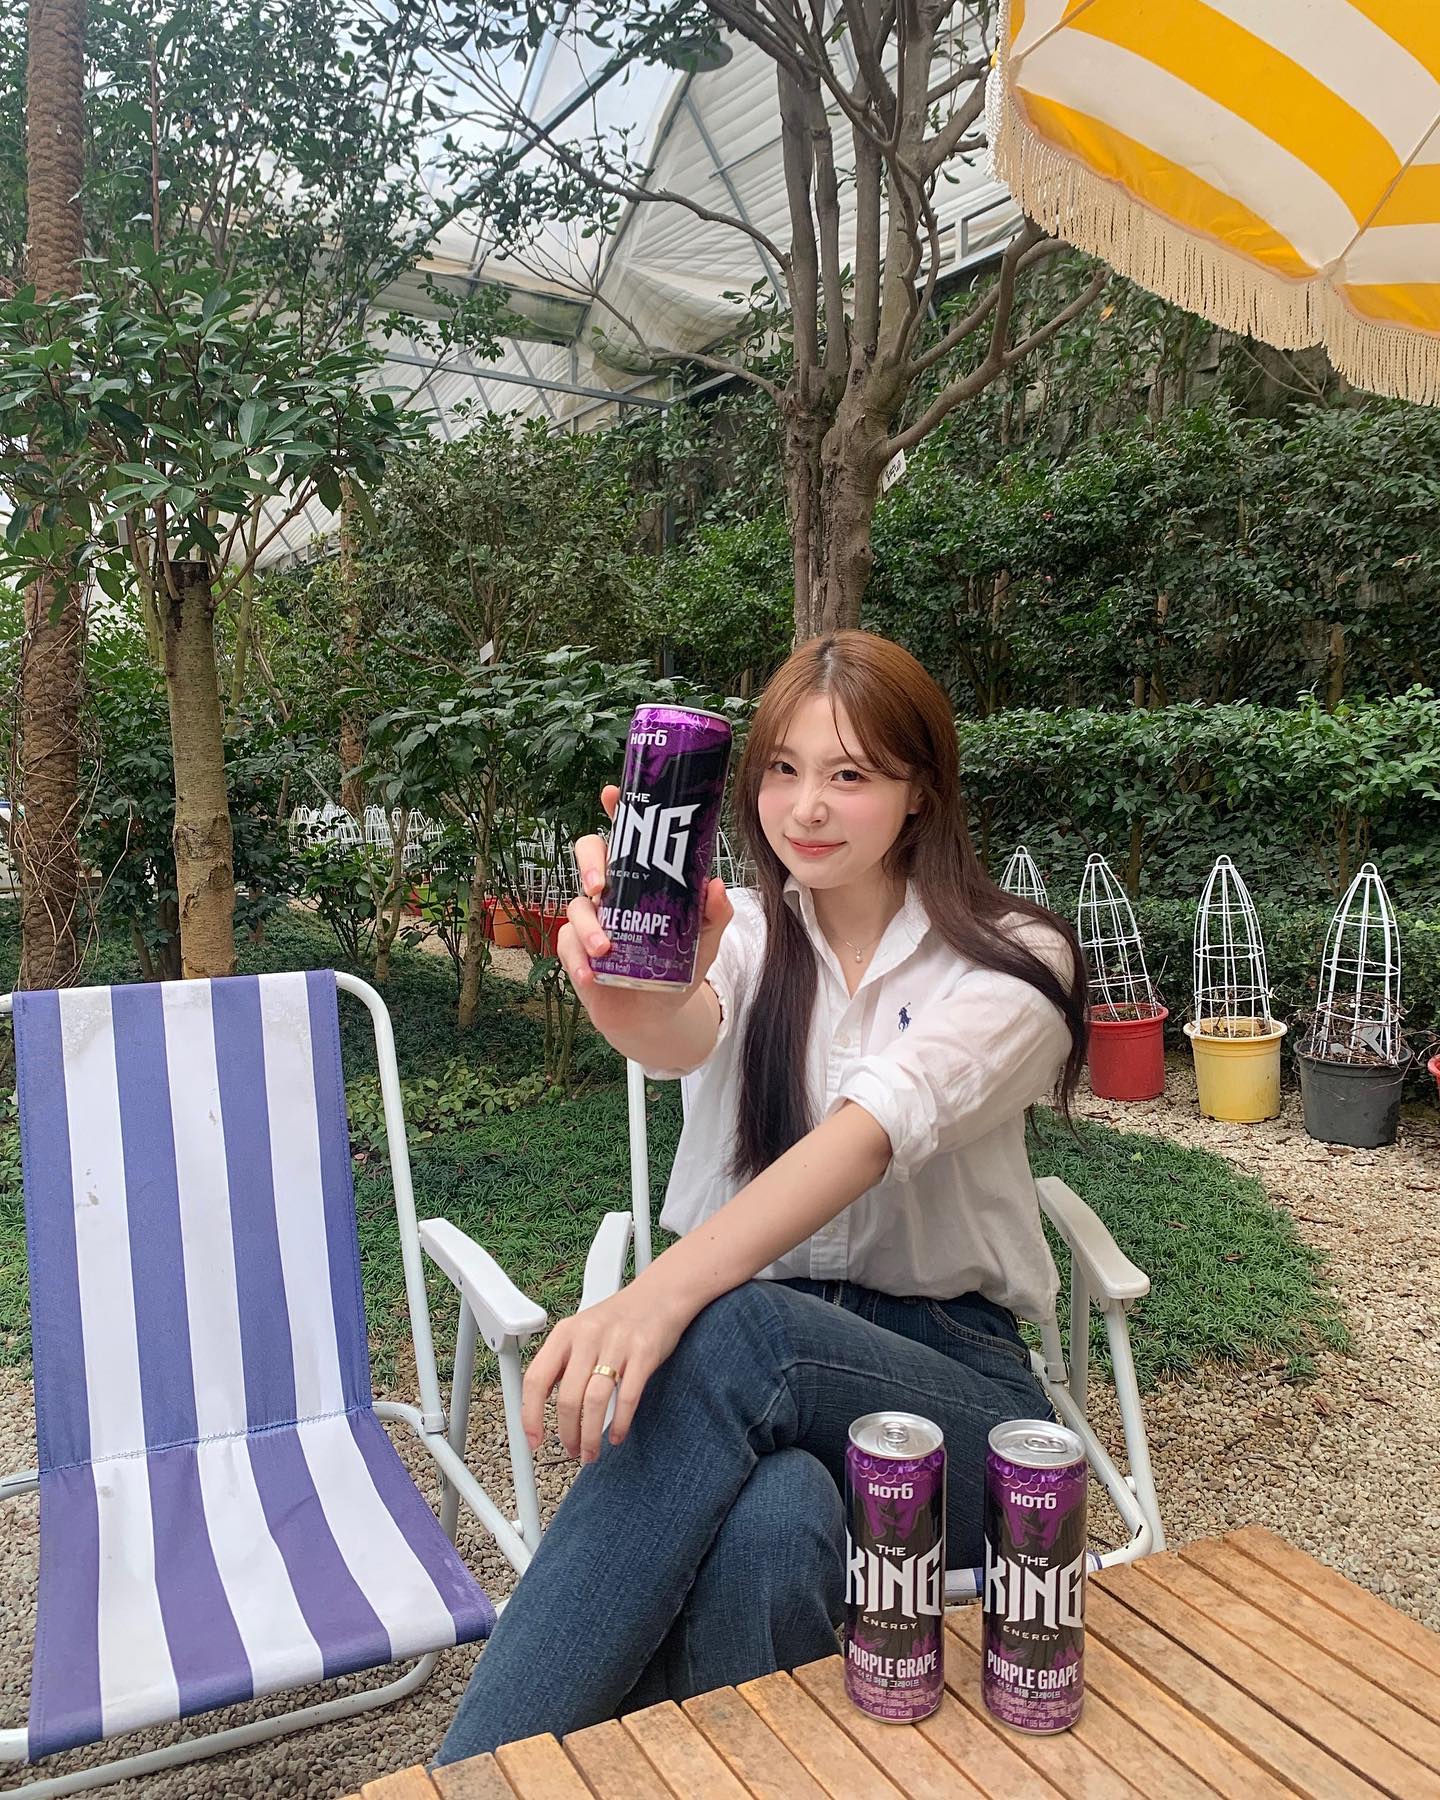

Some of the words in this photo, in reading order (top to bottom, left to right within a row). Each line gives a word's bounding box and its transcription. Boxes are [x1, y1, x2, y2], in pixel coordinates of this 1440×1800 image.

[630, 729, 669, 747] HOT6
[626, 792, 651, 803] THE
[608, 800, 702, 888] ING
[621, 909, 671, 937] GRAPE
[868, 1482, 914, 1500] HOT6
[1010, 1491, 1057, 1509] HOT6
[875, 1543, 907, 1556] THE
[1017, 1553, 1049, 1567] THE
[845, 1525, 944, 1619] KING
[983, 1532, 1086, 1630] KING
[862, 1615, 918, 1630] ENERGY
[1002, 1625, 1060, 1641] ENERGY
[848, 1639, 894, 1678] PURPLE
[896, 1649, 937, 1679] GRAPE
[987, 1648, 1035, 1689] PURPLE
[1037, 1661, 1079, 1690] GRAPE
